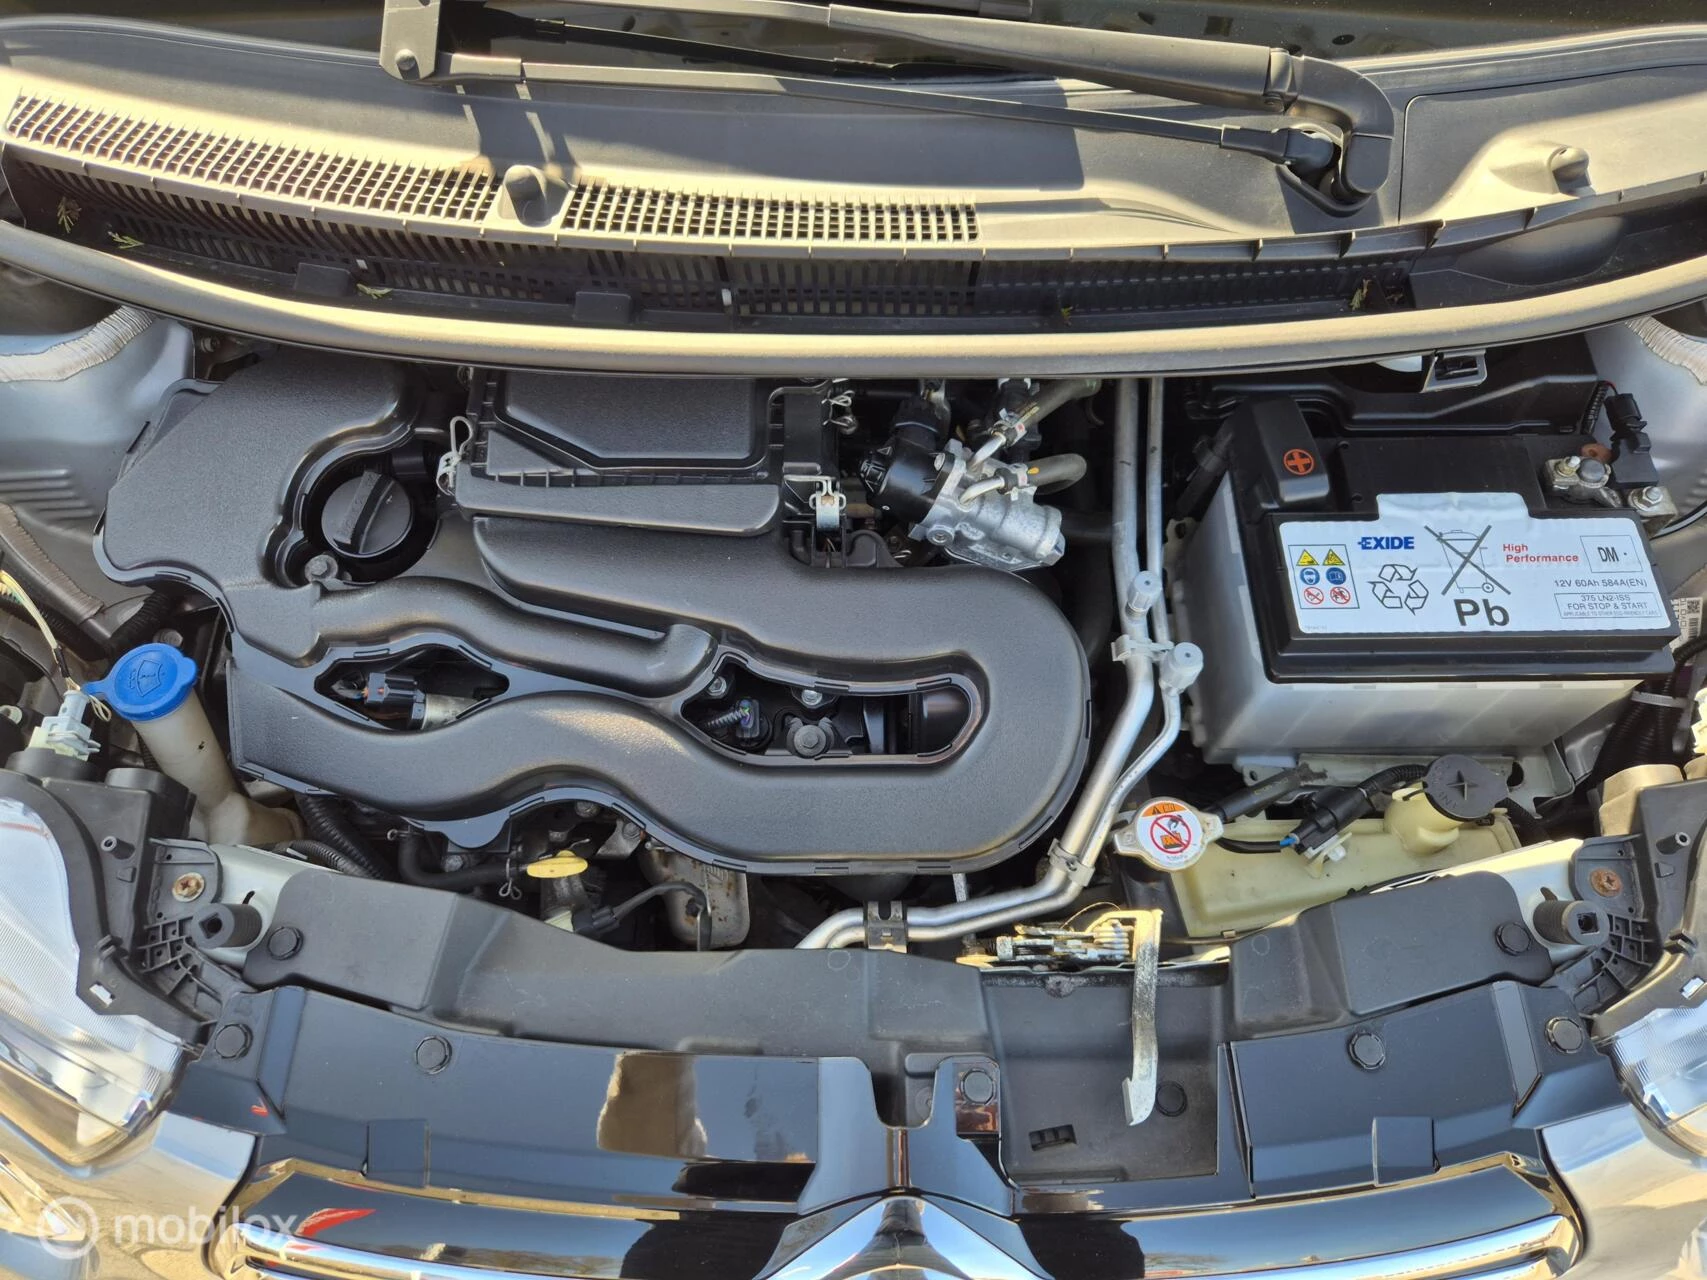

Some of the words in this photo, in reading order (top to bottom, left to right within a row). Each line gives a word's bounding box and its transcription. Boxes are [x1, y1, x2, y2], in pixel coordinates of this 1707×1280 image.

[1358, 536, 1415, 550] EXIDE
[1502, 543, 1529, 554] High
[1505, 553, 1580, 563] Performance
[1597, 546, 1620, 562] DM
[1554, 579, 1573, 588] 12V
[1575, 579, 1600, 588] 60Ah
[1602, 578, 1648, 588] 584A(EN)
[1581, 594, 1596, 602] 375
[1567, 602, 1586, 610] FOR
[1588, 602, 1611, 610] STOP
[1613, 602, 1620, 610] &
[1621, 601, 1649, 610] START
[1453, 597, 1510, 626] Pb
